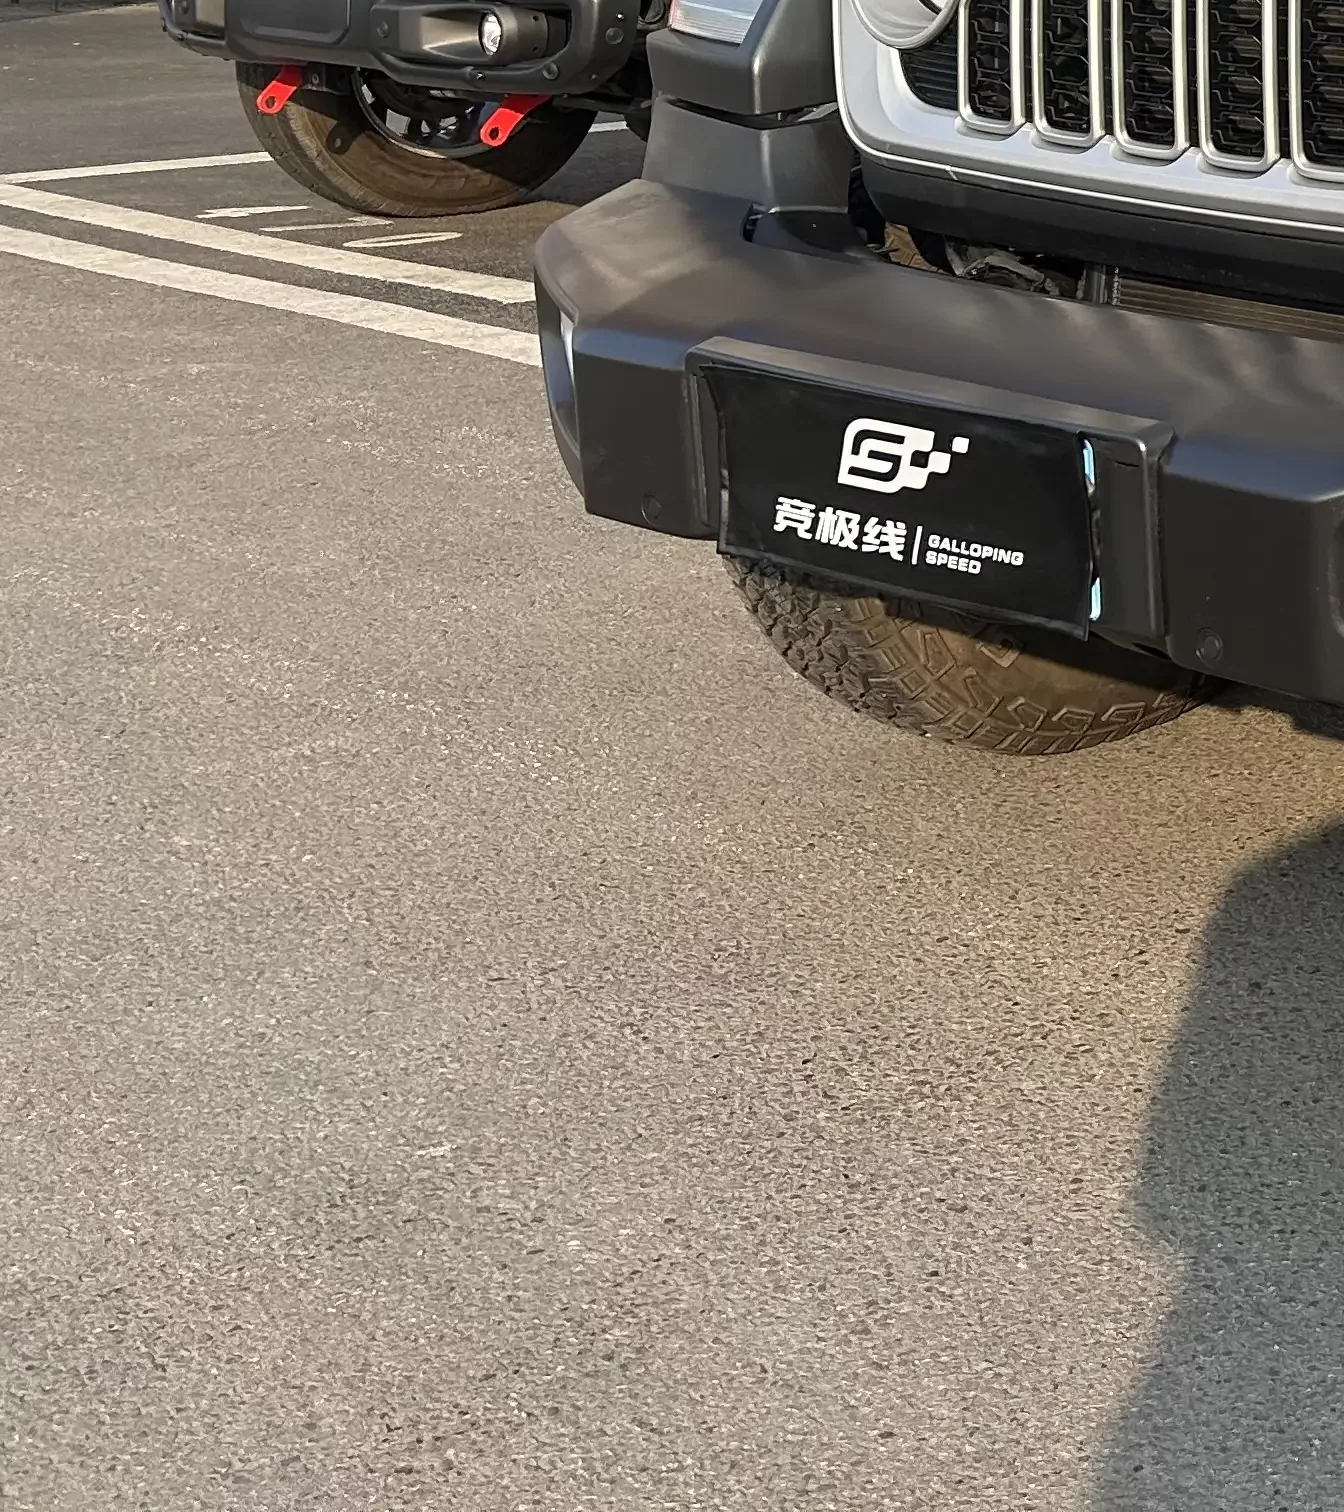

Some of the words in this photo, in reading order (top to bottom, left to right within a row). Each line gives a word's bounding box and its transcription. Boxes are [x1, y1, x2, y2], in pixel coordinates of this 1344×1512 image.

[773, 495, 908, 562] 竞极线
[925, 551, 982, 575] SPEED
[926, 533, 1025, 567] GALLOPING
